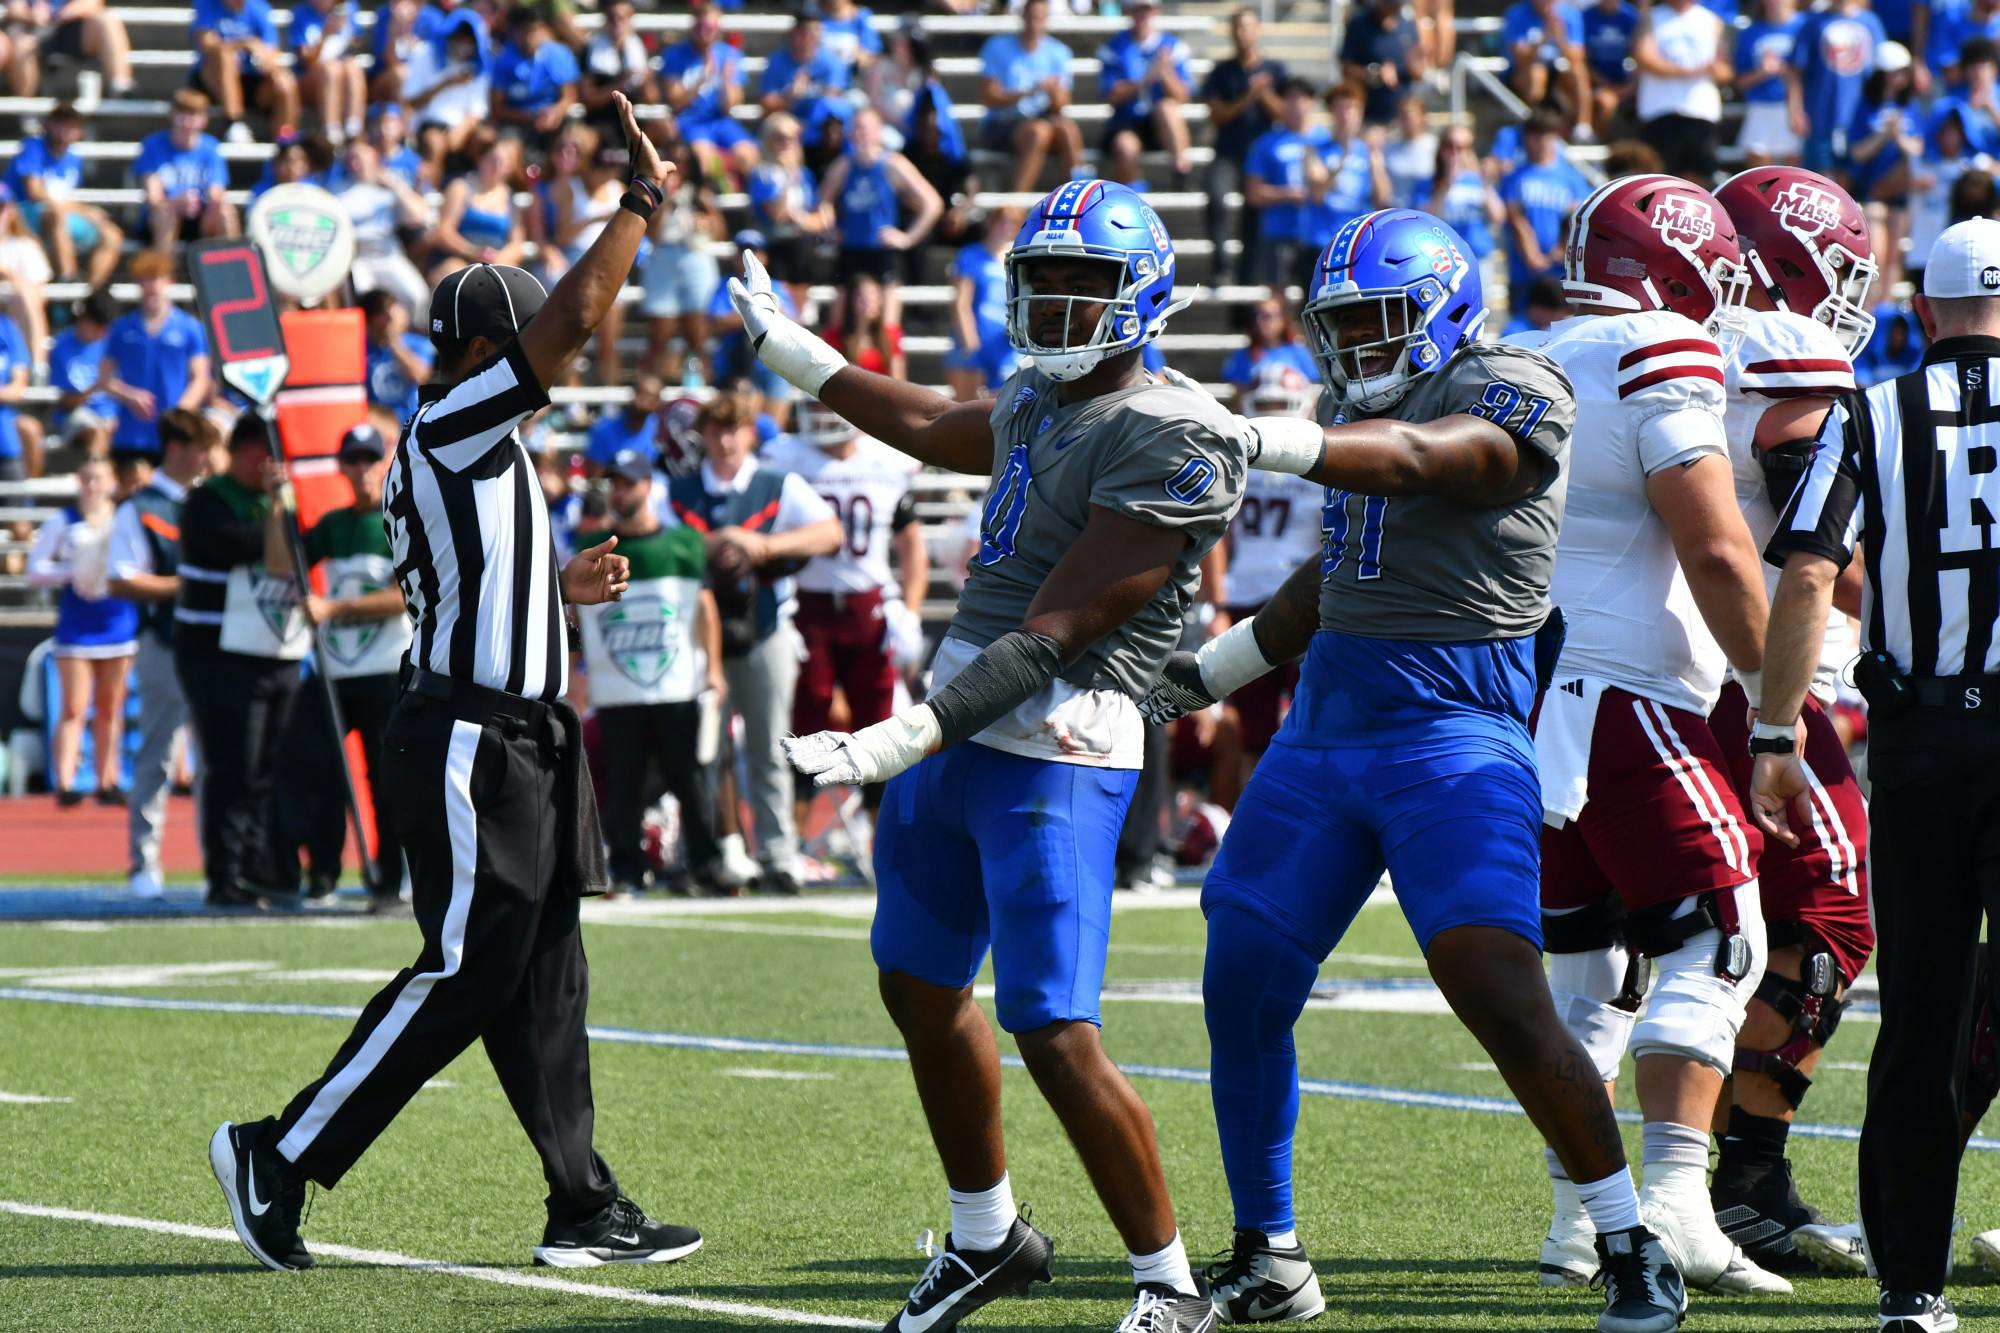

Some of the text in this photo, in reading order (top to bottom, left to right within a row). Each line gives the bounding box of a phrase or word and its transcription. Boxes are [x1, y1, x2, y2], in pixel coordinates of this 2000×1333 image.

[1651, 204, 1715, 241] MASS
[1984, 270, 2000, 285] RR
[201, 247, 276, 362] 2
[432, 318, 443, 333] RR
[1468, 381, 1551, 438] 91
[1165, 456, 1217, 505] 0
[1936, 421, 2000, 554] R
[1965, 687, 1982, 709] S
